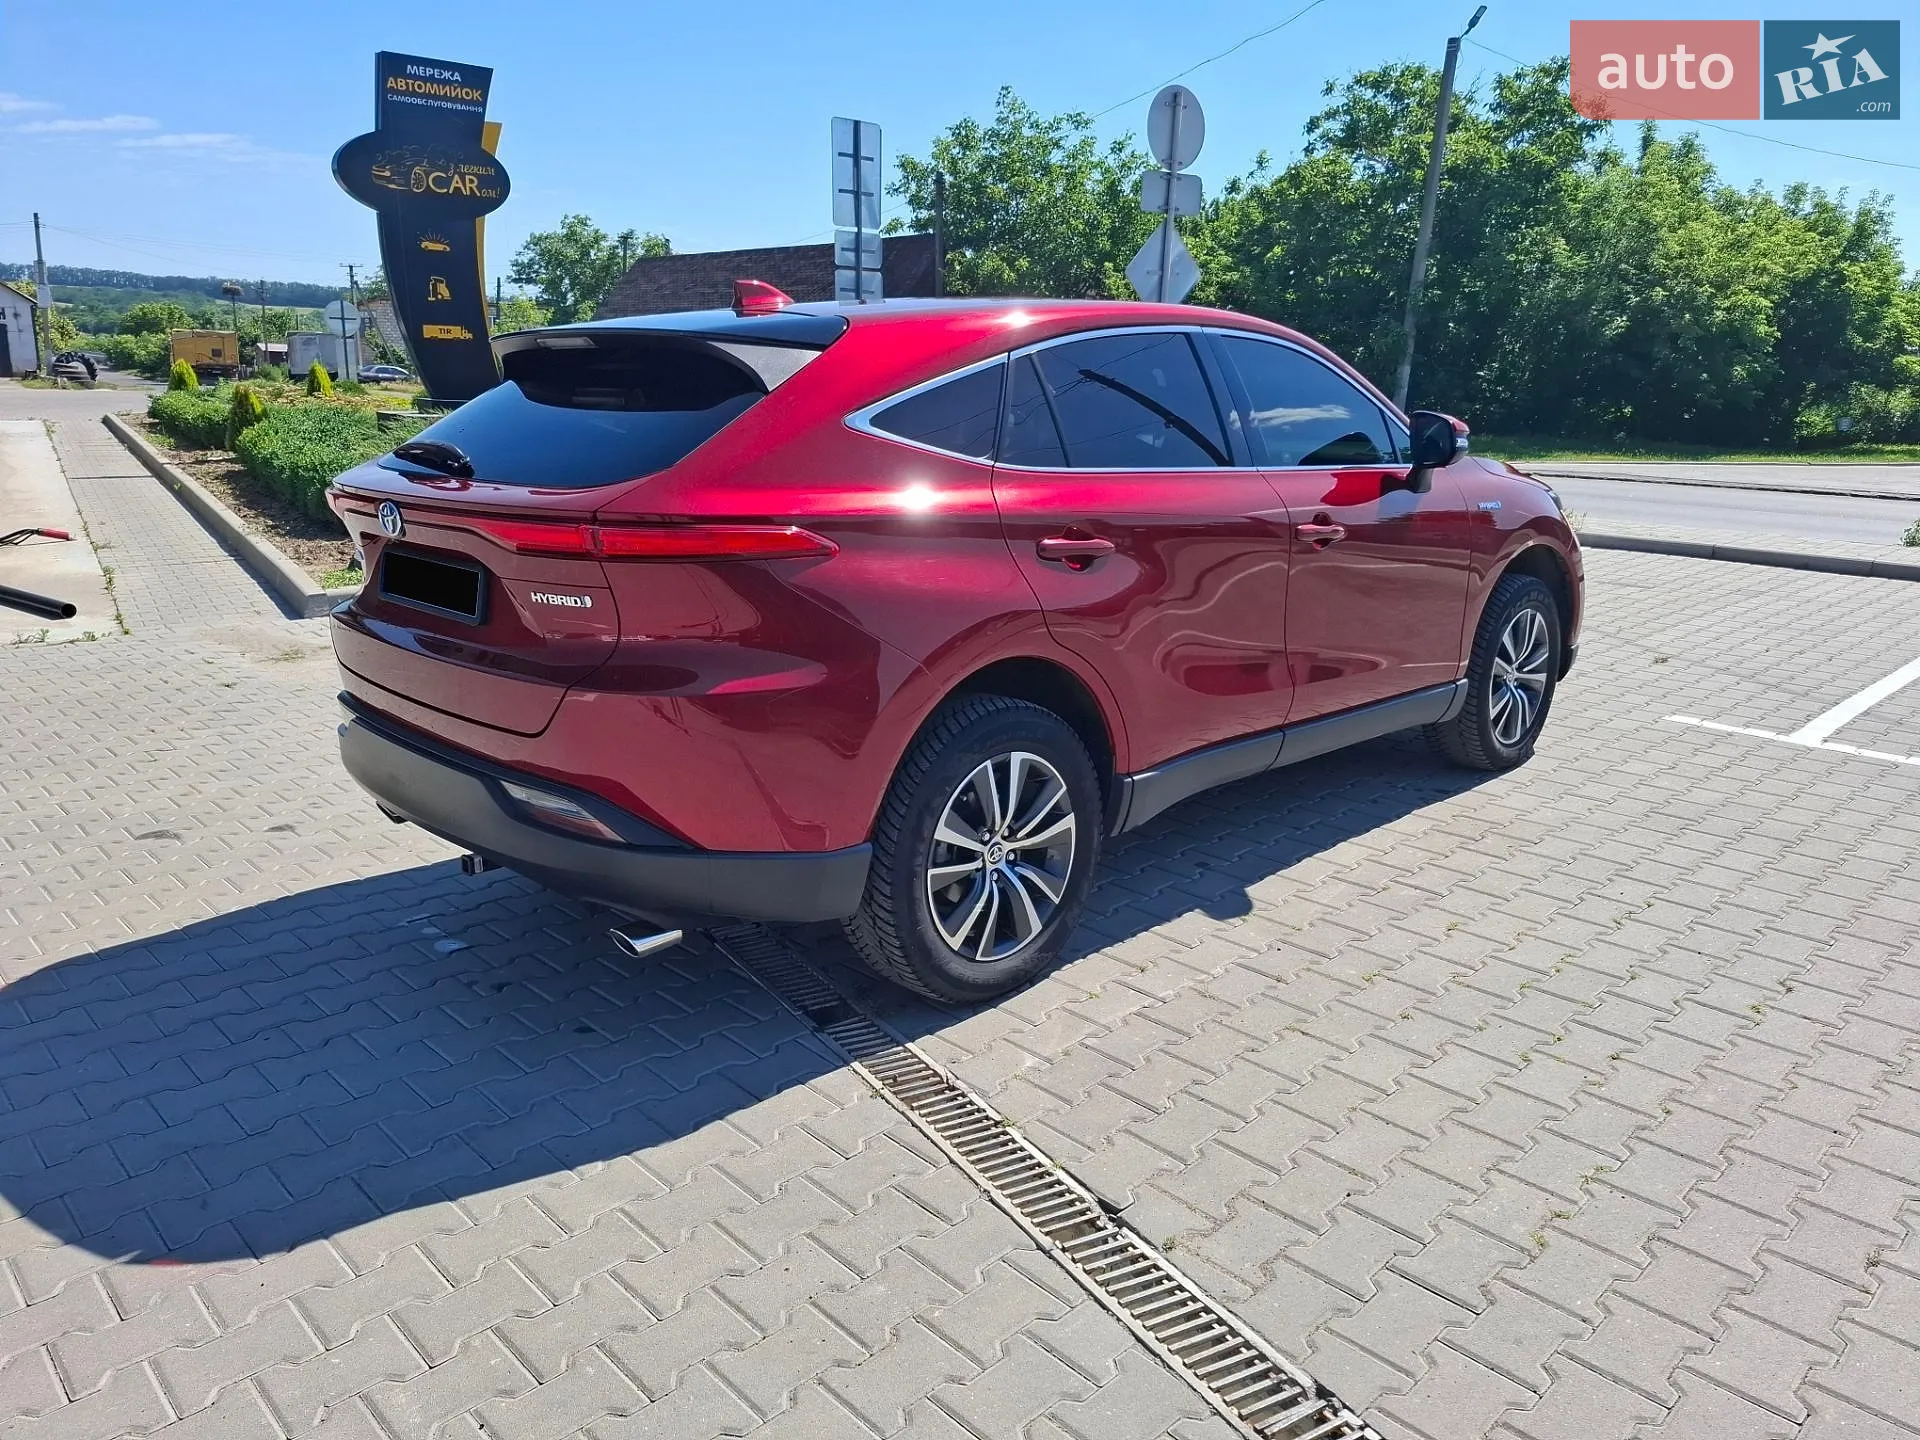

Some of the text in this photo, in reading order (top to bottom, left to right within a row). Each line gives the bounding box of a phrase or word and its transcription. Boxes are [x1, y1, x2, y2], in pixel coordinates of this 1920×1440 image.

[406, 64, 461, 81] МЕРЕЖА
[387, 76, 482, 101] АВТОМИЙОК
[387, 94, 483, 112] САМООБСЛУГОВУВАННЯ
[439, 327, 453, 335] TIR
[530, 591, 581, 607] HYBRID
